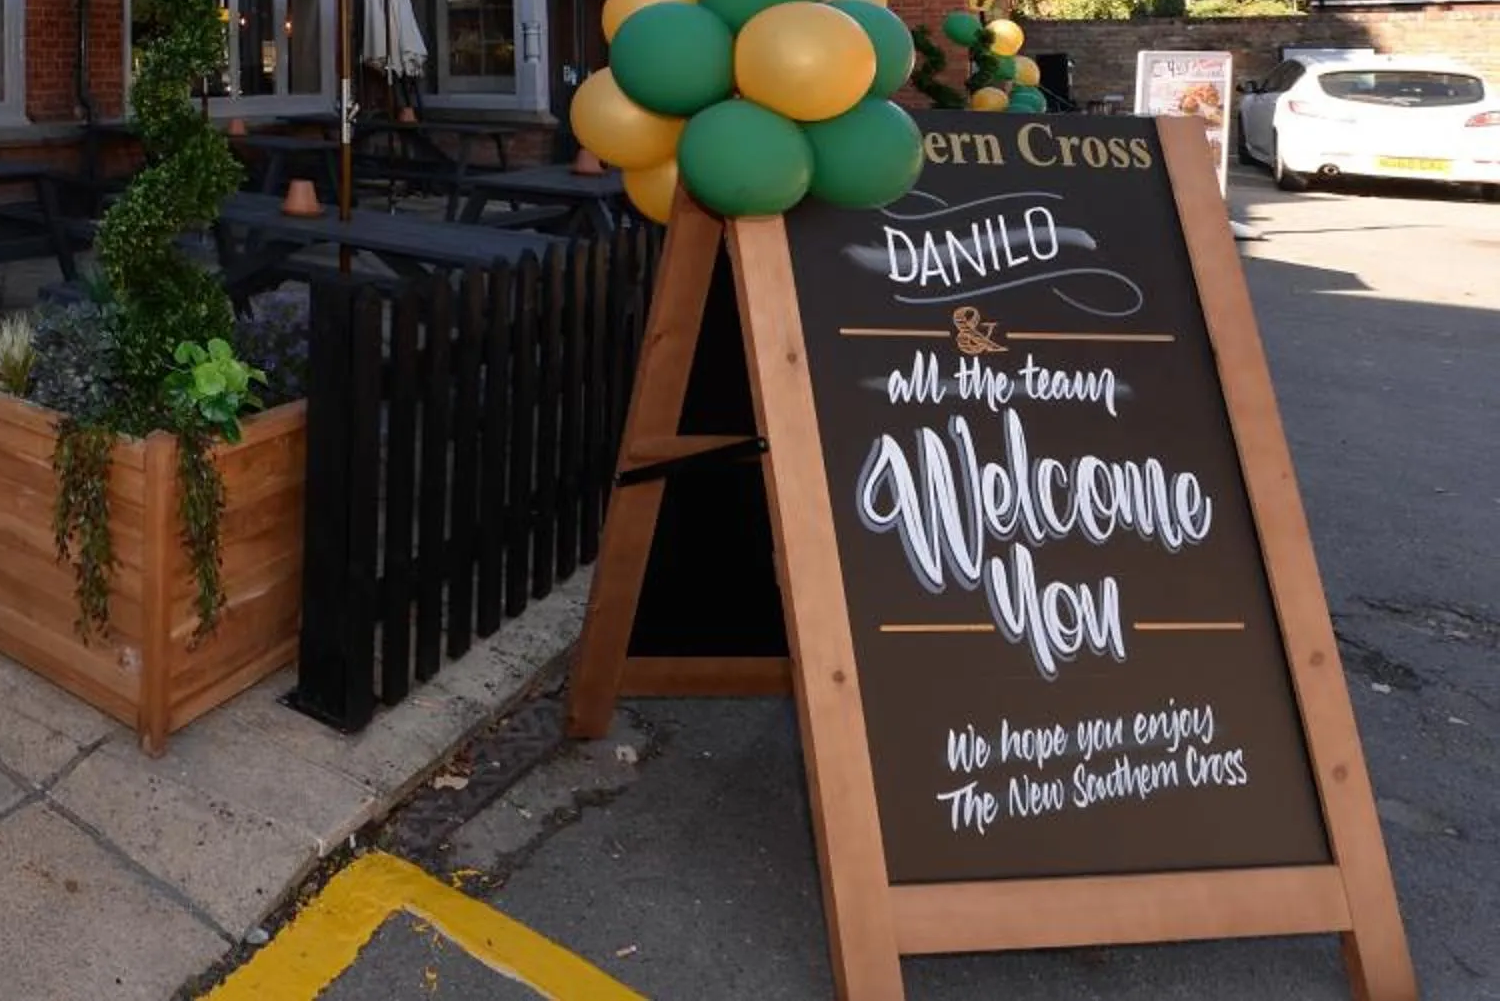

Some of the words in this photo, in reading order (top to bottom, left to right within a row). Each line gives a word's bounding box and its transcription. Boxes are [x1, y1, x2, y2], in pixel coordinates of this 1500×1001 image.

[1016, 122, 1152, 169] Cross
[883, 206, 1059, 288] DANILO
[952, 306, 1009, 355] &
[887, 350, 946, 405] all
[953, 355, 1015, 413] the
[1018, 353, 1118, 418] team
[856, 408, 1213, 593] Welcome
[983, 543, 1127, 681] You
[947, 724, 992, 773] We
[1001, 718, 1069, 770] hope
[1077, 717, 1124, 761] you
[1133, 698, 1214, 752] enjoy
[936, 780, 999, 835] The
[1008, 774, 1064, 817] New
[1072, 754, 1179, 808] Southern
[1186, 746, 1248, 787] Cross
